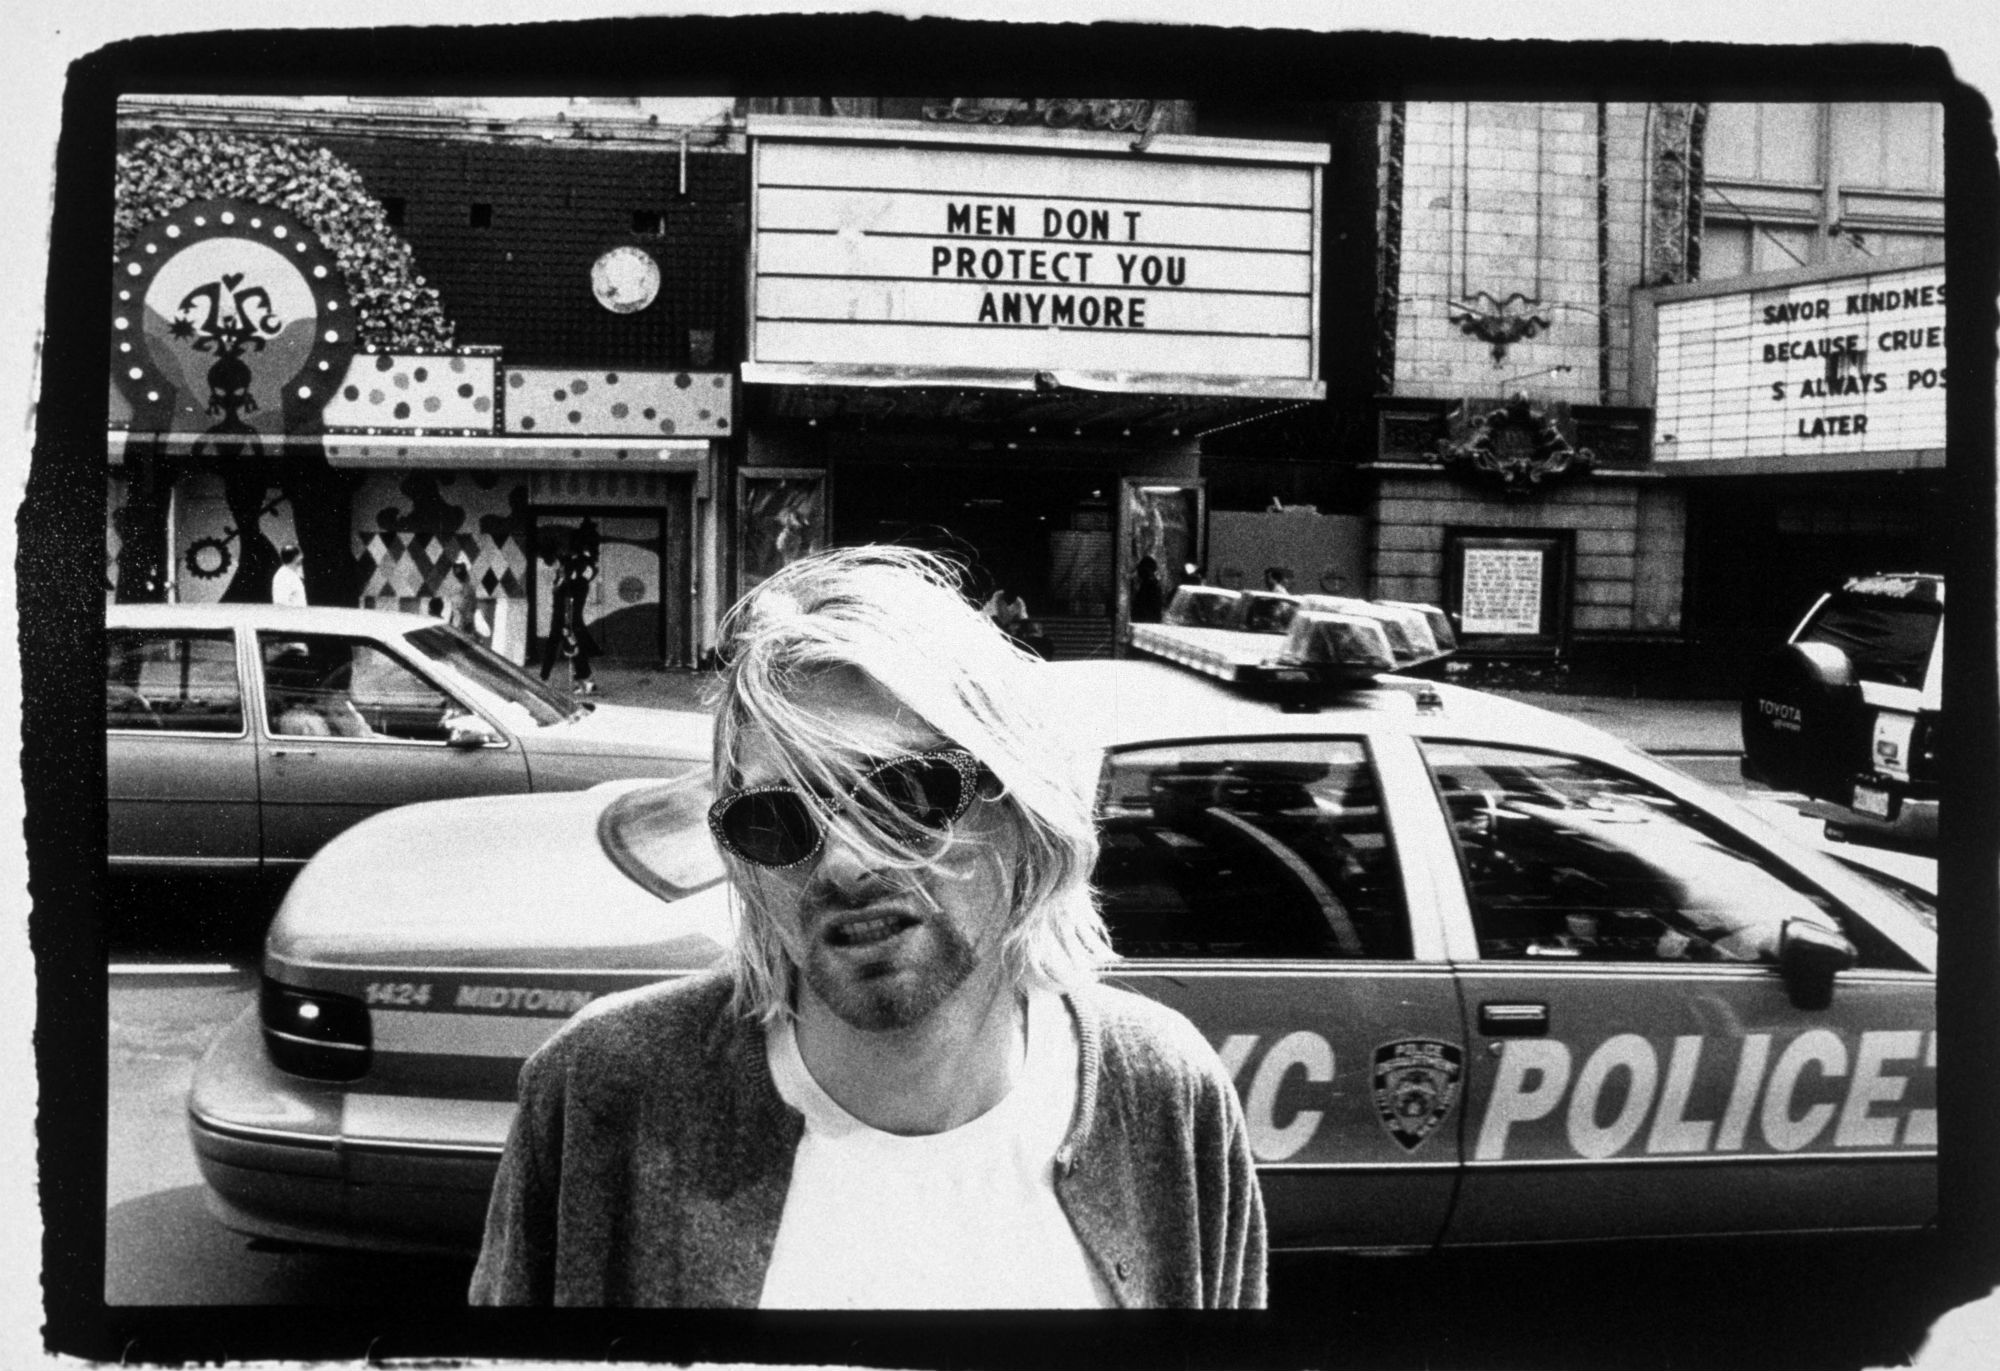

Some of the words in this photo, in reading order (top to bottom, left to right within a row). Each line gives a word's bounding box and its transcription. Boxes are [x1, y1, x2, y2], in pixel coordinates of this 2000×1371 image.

[947, 203, 1015, 236] MEN
[932, 246, 1093, 282] PROTECT
[1116, 253, 1186, 286] YOU
[978, 292, 1146, 328] ANYMORE
[1763, 335, 1859, 363] BECAUSE
[1878, 326, 1946, 352] CRUE
[1800, 373, 1887, 399] ALWAYS
[1799, 414, 1868, 438] LATER
[1759, 699, 1801, 722] TOYOTA
[1475, 1029, 1922, 1161] POLICE
